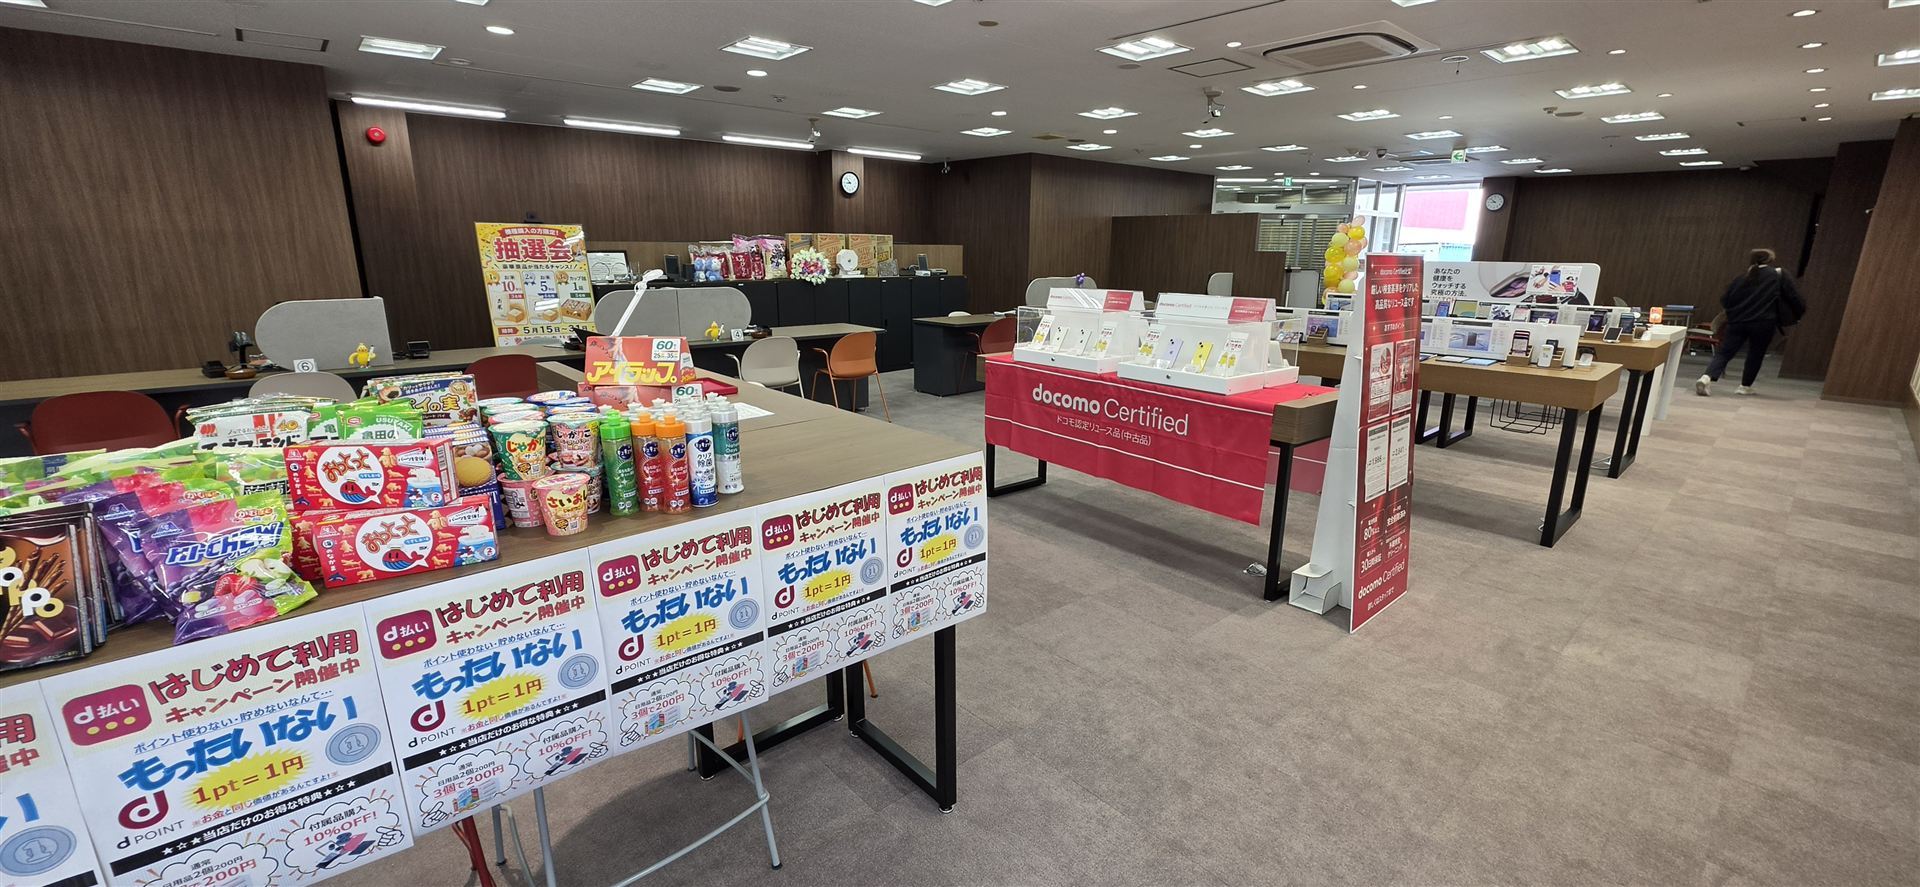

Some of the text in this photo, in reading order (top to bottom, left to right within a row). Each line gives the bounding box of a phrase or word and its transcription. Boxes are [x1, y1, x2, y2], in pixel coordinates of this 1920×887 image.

[494, 238, 573, 261] 抽選会
[1430, 289, 1468, 297] 究極の方法。
[1432, 282, 1467, 290] ウォッチする
[376, 416, 413, 432] USUYAKI
[1032, 383, 1189, 436] docomo Certified
[1056, 415, 1152, 446] ドコモ認定リユース品(中古品)
[321, 448, 372, 484] おっとっと
[914, 465, 983, 497] はじめて利用
[795, 492, 881, 530] はじめて利用
[890, 492, 912, 503] d払い
[917, 483, 983, 509] キャンペーン開催中
[360, 515, 418, 553] おっとっと
[765, 523, 791, 538] d払い
[799, 511, 880, 543] キャンペーン開催中
[900, 506, 979, 547] もったいない
[166, 521, 285, 566] HI-CHEW
[641, 525, 753, 571] はじめて利用
[602, 564, 637, 583] d払い
[648, 547, 753, 586] キャンペーン開催中
[778, 537, 876, 585] もったいない
[1358, 559, 1406, 600] docomo Certified
[435, 570, 585, 629] はじめて利用
[621, 576, 748, 635] もったいない
[779, 606, 800, 619] POINT
[383, 621, 430, 643] d払い
[445, 595, 585, 645] キャンペーン開催中
[844, 619, 877, 637] 10%OFF!
[848, 613, 874, 627] 付属品購入
[148, 629, 359, 705] はじめて利用
[411, 629, 583, 700] もったいない
[624, 657, 651, 672] POINT
[711, 668, 752, 688] 10%OFF!
[714, 661, 748, 678] 付属品購入
[165, 658, 361, 723] キャンペーン開催中
[73, 697, 142, 726] d払い
[631, 694, 685, 720] 3個で200円
[408, 727, 456, 748] d POINT
[468, 710, 554, 746] 当店だけのお得な特典
[538, 730, 592, 757] 10%OFF!
[543, 724, 585, 744] 付属品購入
[117, 696, 358, 792] もったいない
[433, 764, 505, 799] 3個で200円
[201, 791, 324, 843] 当店だけのお得な特典
[303, 811, 378, 847] 10%OFF!
[308, 804, 367, 833] 付属品購入
[117, 819, 184, 850] d POINT
[191, 859, 212, 871] 通常
